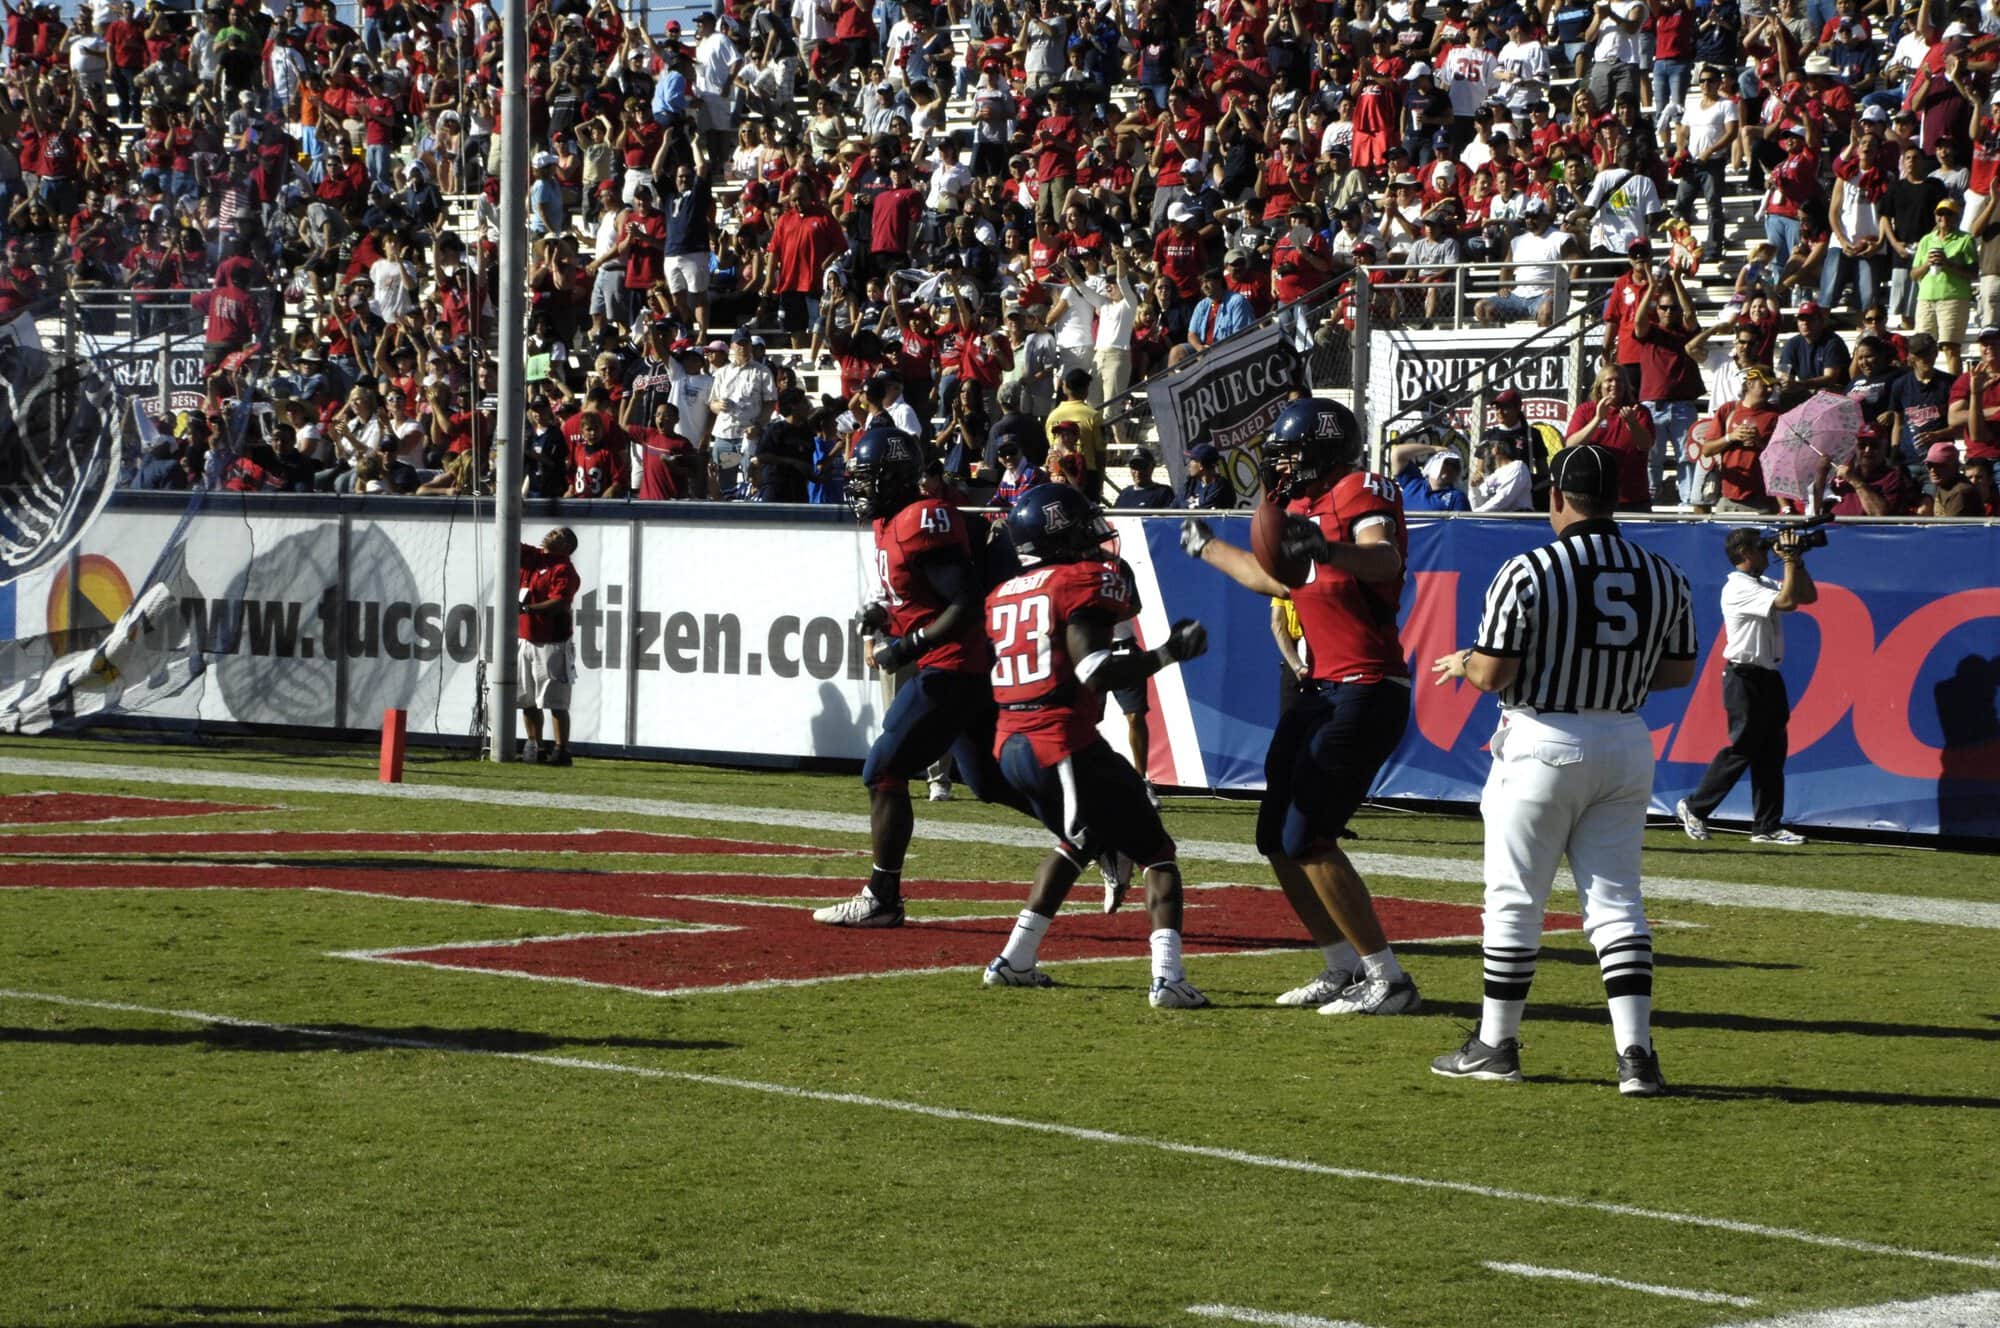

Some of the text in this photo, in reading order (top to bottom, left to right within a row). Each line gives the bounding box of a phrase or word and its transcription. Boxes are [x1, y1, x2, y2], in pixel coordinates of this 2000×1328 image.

[1181, 353, 1291, 444] BRUEGG
[1218, 416, 1265, 448] BAKED
[1316, 411, 1345, 440] A
[886, 436, 911, 461] A
[573, 466, 603, 495] 83
[920, 508, 952, 534] 49
[1041, 501, 1071, 535] A
[1593, 572, 1640, 647] S
[990, 594, 1055, 688] 23
